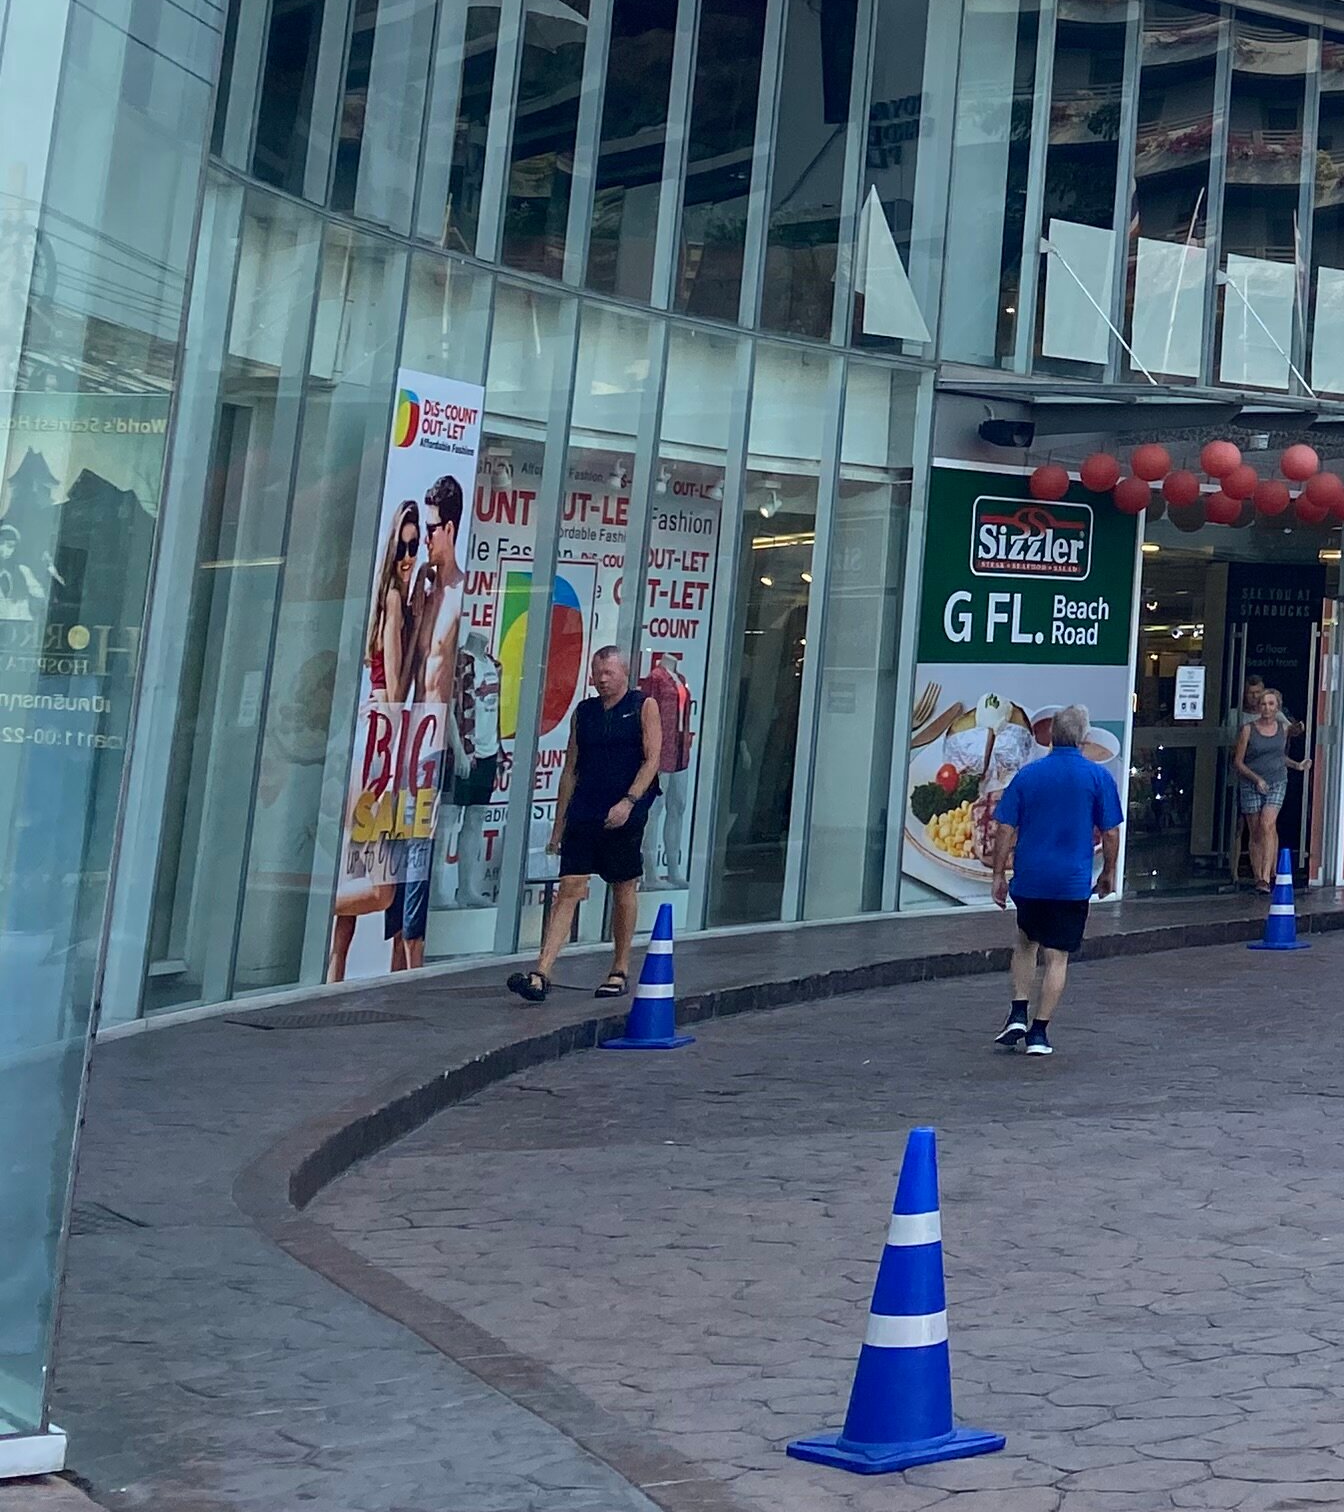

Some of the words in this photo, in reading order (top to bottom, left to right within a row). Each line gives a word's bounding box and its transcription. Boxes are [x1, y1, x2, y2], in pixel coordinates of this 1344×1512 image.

[421, 418, 466, 441] OUT-LET
[978, 524, 1085, 564] Sizzler
[943, 590, 973, 643] G
[986, 592, 1044, 644] FL.
[1053, 594, 1109, 620] Beach
[1051, 620, 1099, 646] Road
[362, 710, 437, 801] BIG
[352, 788, 435, 844] SALE
